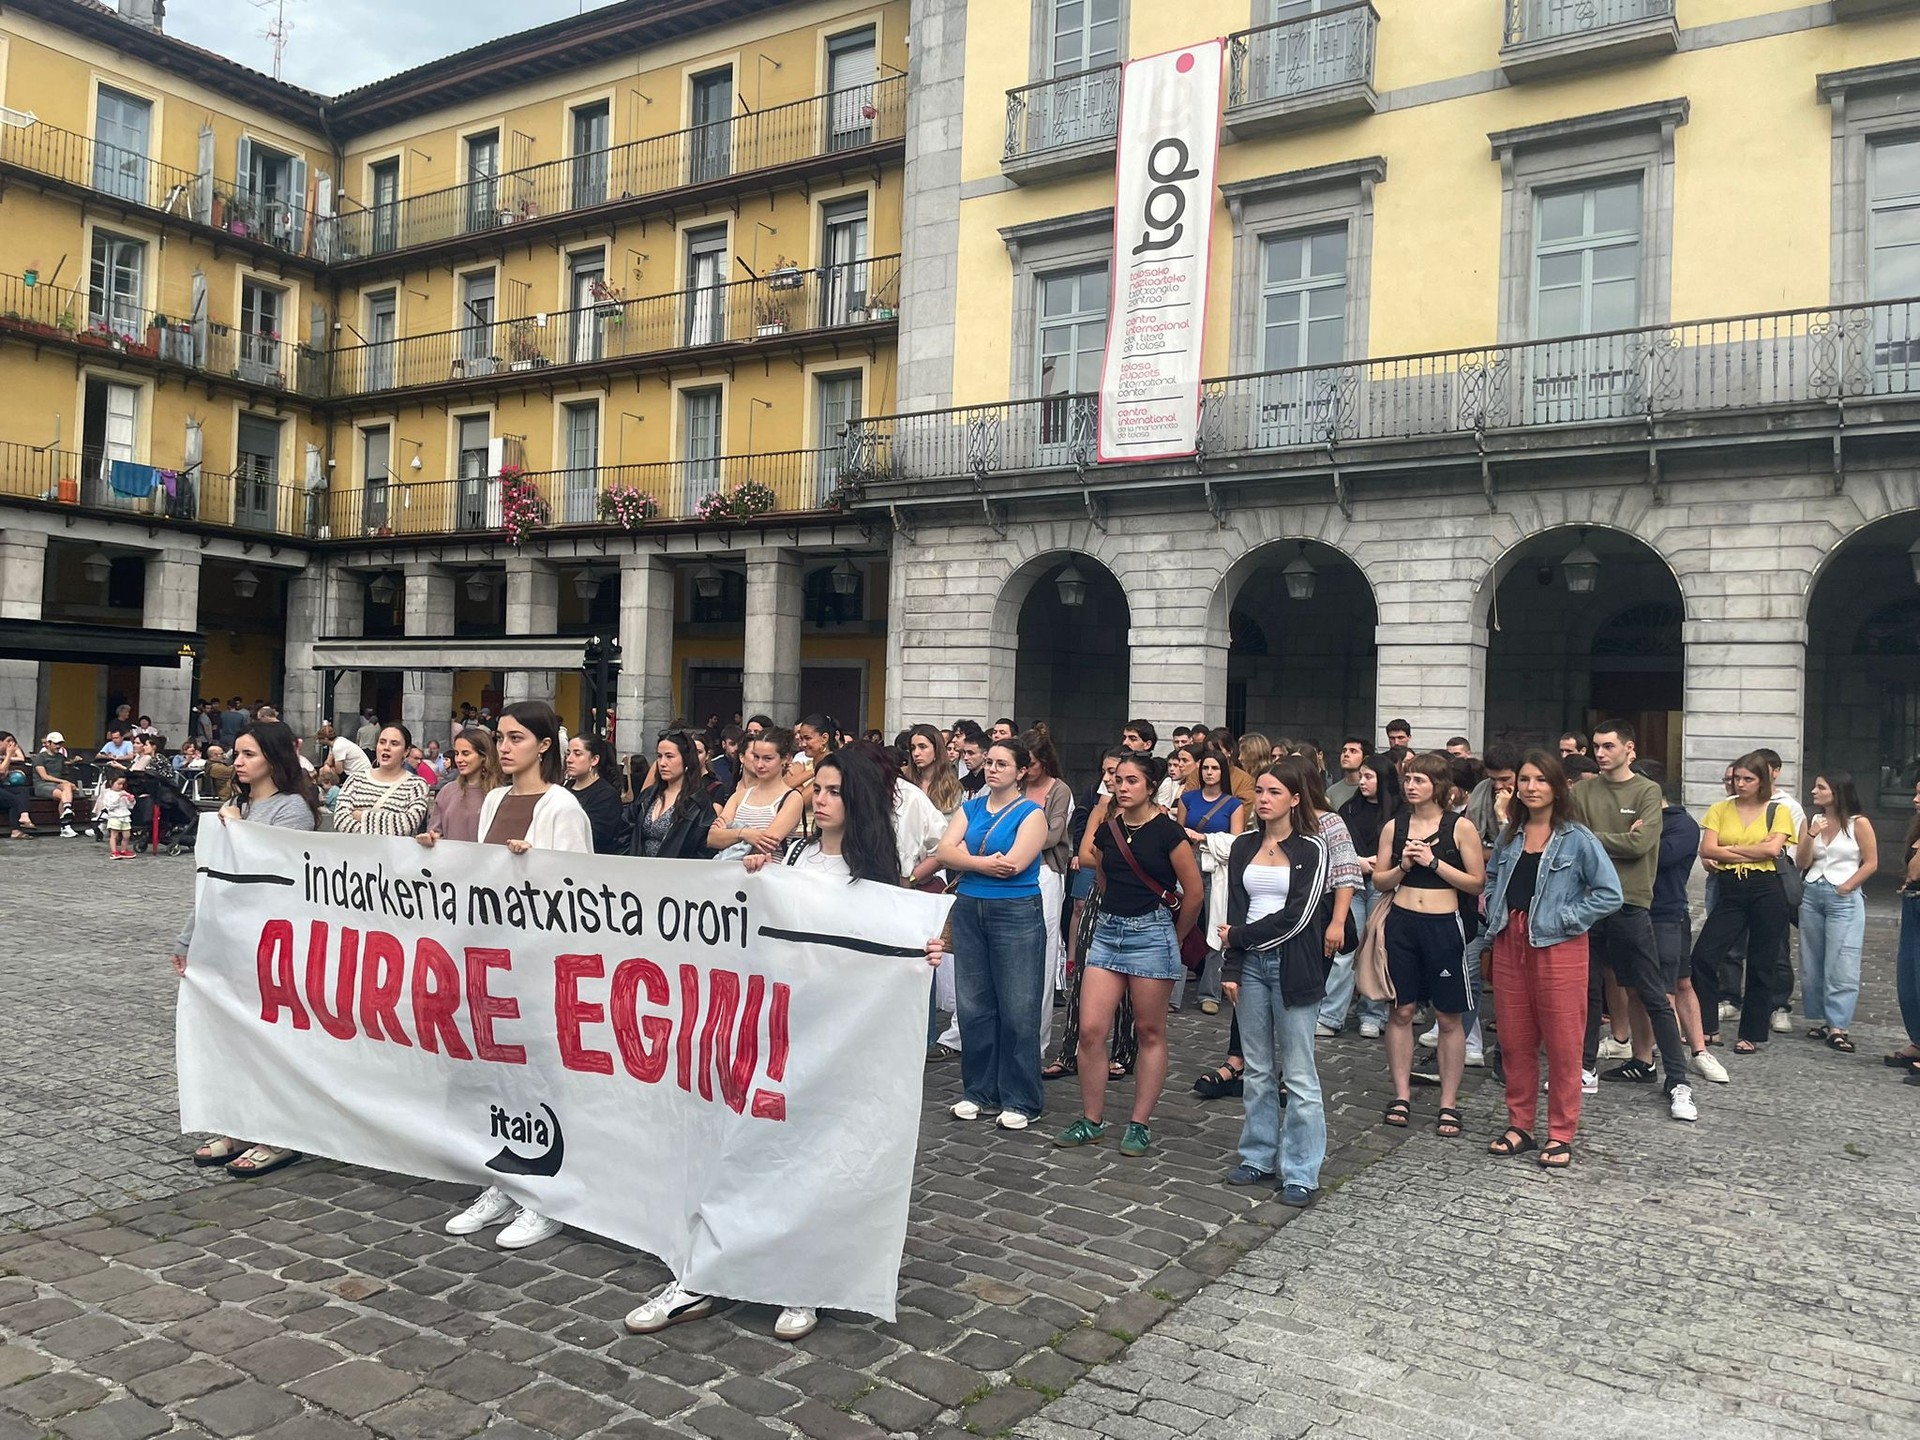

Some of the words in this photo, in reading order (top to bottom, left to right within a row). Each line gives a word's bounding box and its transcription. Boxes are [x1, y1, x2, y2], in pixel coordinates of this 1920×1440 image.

[1129, 267, 1170, 281] tolosako
[1129, 274, 1186, 291] nazioarteko
[1126, 315, 1156, 326] centro
[1126, 319, 1190, 336] internacional
[1123, 344, 1134, 353] de
[1136, 340, 1166, 350] tolosa
[1121, 362, 1151, 372] tolosa
[1119, 369, 1160, 382] puppets
[1119, 375, 1177, 389] international
[1117, 388, 1147, 397] center
[1118, 413, 1177, 426] international
[303, 851, 457, 926] indarkeria
[468, 877, 642, 936] matxista
[657, 890, 748, 949] orori
[256, 919, 527, 1065] AURRE
[553, 953, 792, 1122] EGIN!
[490, 1104, 549, 1148] itaia
